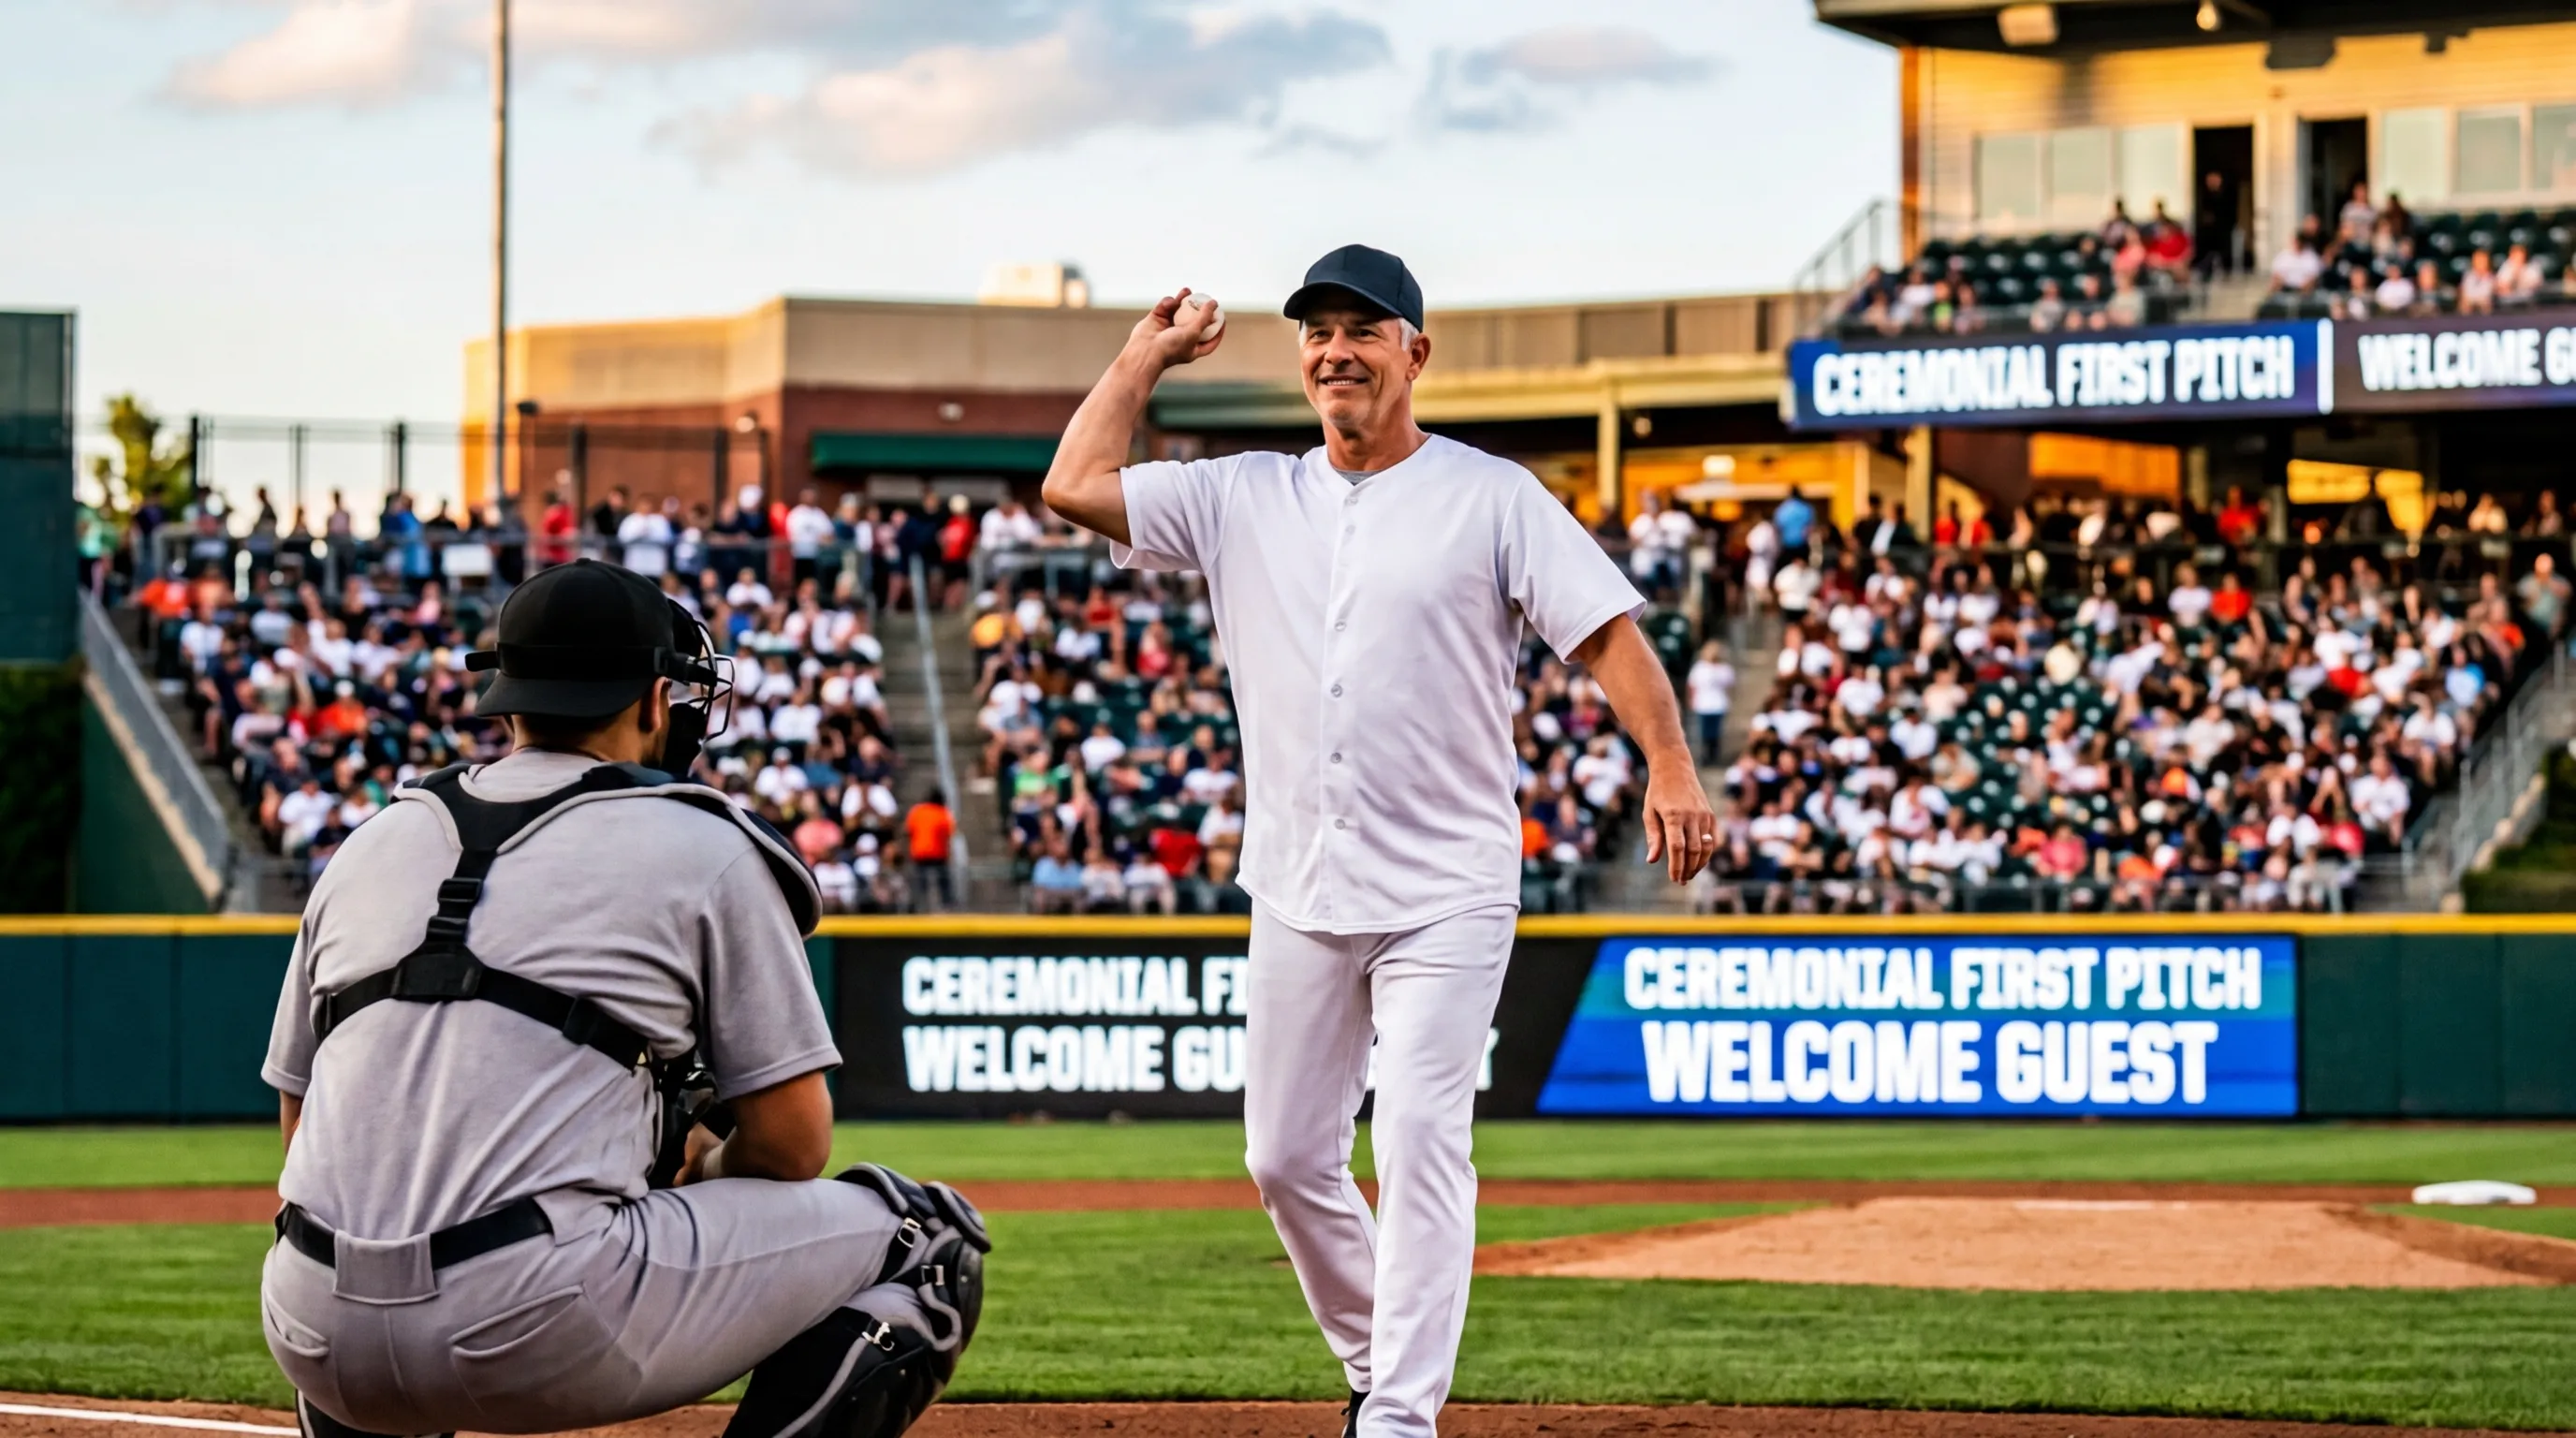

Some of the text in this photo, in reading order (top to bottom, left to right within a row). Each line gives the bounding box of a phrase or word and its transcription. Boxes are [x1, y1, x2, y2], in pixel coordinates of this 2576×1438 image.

[1813, 334, 2295, 417] CEREMONIAL FIRST PITCH
[2357, 327, 2576, 391] WELCOME G
[902, 957, 1249, 1016] CEREMONIAL FI
[1624, 947, 2261, 1009] CEREMONIAL FIRST PITCH
[902, 1025, 1248, 1093] WELCOME GU
[1642, 1020, 2218, 1104] WELCOME GUEST
